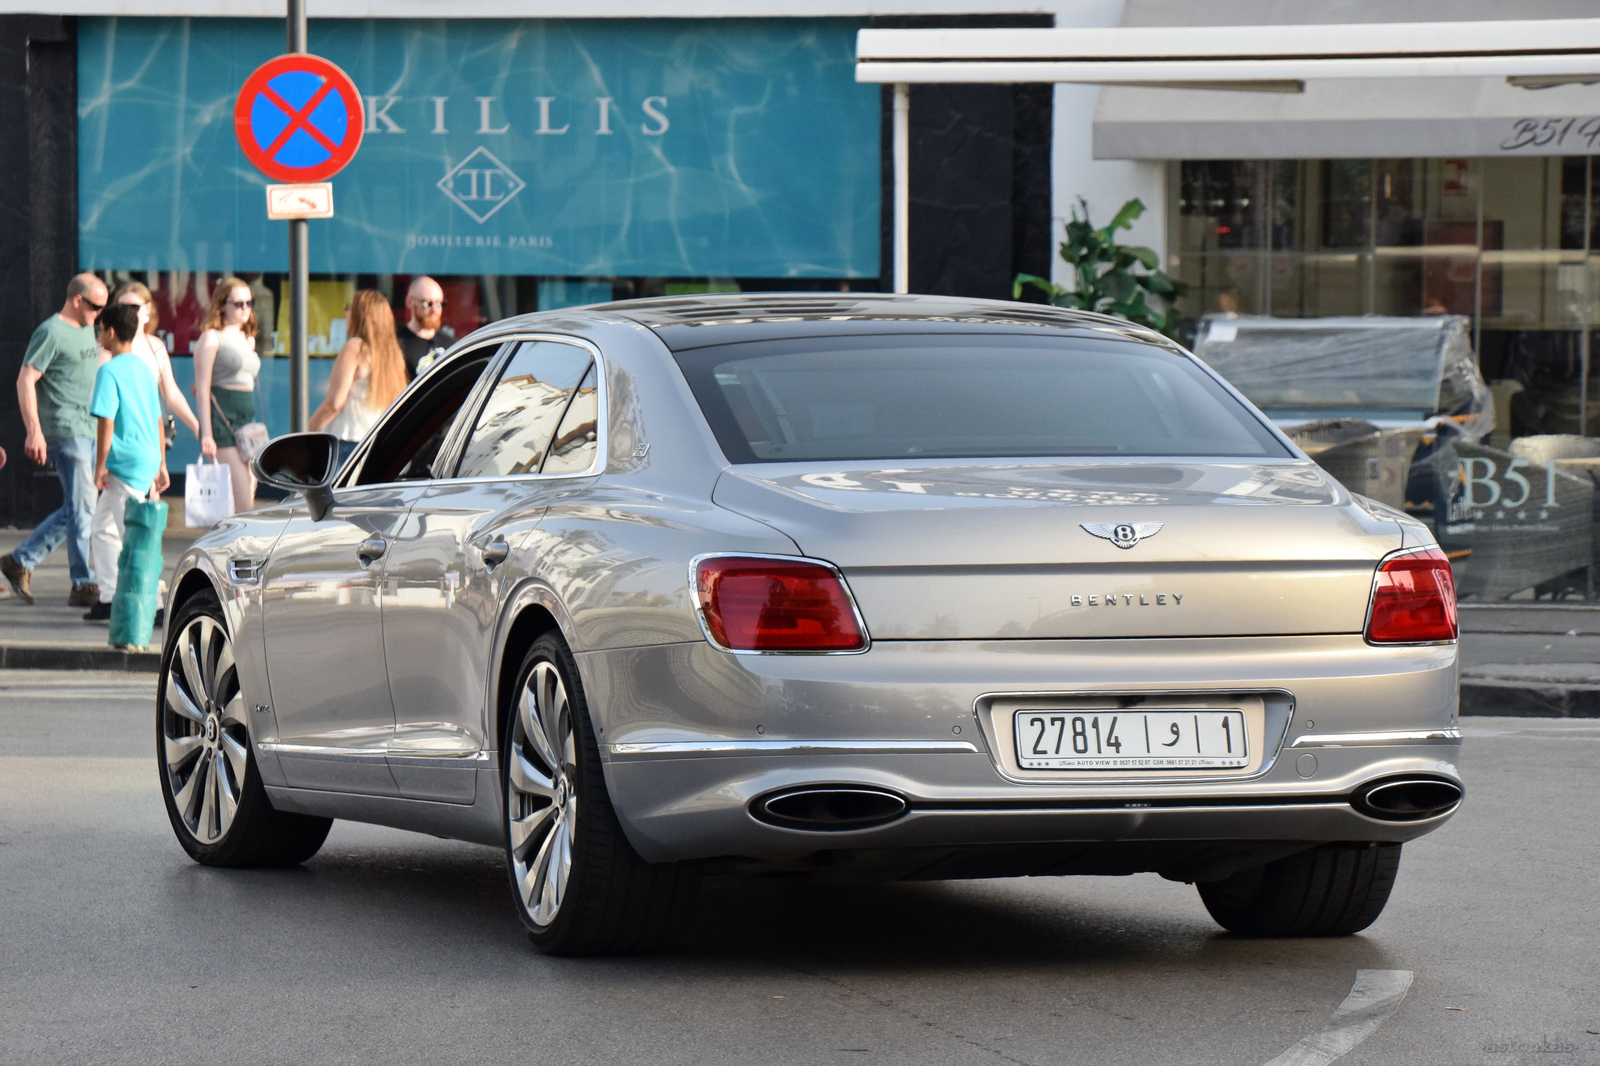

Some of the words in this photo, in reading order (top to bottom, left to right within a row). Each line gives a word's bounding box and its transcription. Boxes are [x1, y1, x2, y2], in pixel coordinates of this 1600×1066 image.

[408, 234, 502, 248] JOAILLERIE
[508, 235, 554, 248] PARIS
[1460, 457, 1561, 508] B51
[1070, 593, 1184, 607] BENTLEY
[1029, 716, 1122, 755] 27814
